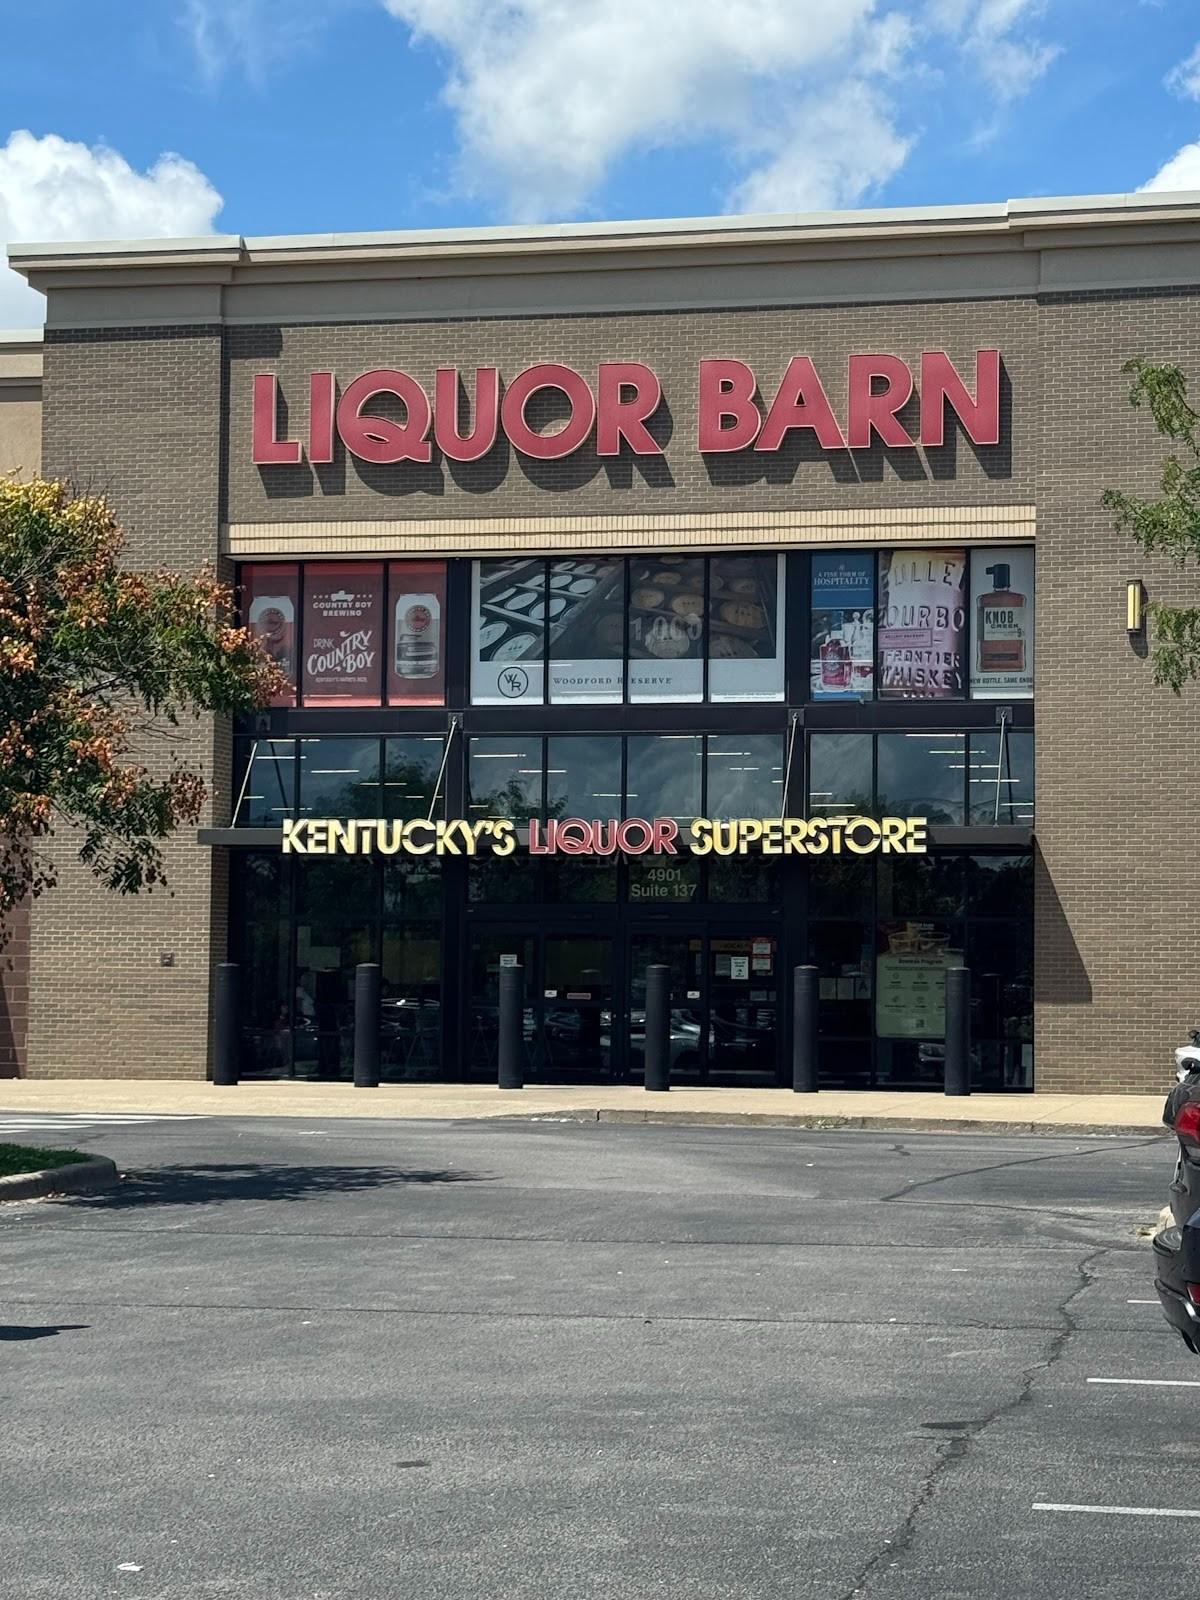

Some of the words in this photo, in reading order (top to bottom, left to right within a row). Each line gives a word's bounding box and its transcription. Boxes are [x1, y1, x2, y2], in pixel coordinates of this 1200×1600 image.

[252, 362, 664, 464] LIQUOR
[698, 349, 1000, 453] BARN
[814, 576, 869, 585] HOSPITALITY
[985, 610, 1014, 624] KNOB
[307, 630, 373, 675] COUNTRY
[343, 651, 375, 673] BOY
[553, 677, 612, 685] WOODFORD
[282, 817, 515, 856] KENTUCKY'S
[528, 818, 678, 855] LIQUOR
[690, 817, 927, 856] SUPERSTORE
[647, 868, 682, 881] 4901
[631, 884, 670, 897] Suite
[672, 884, 697, 897] 137
